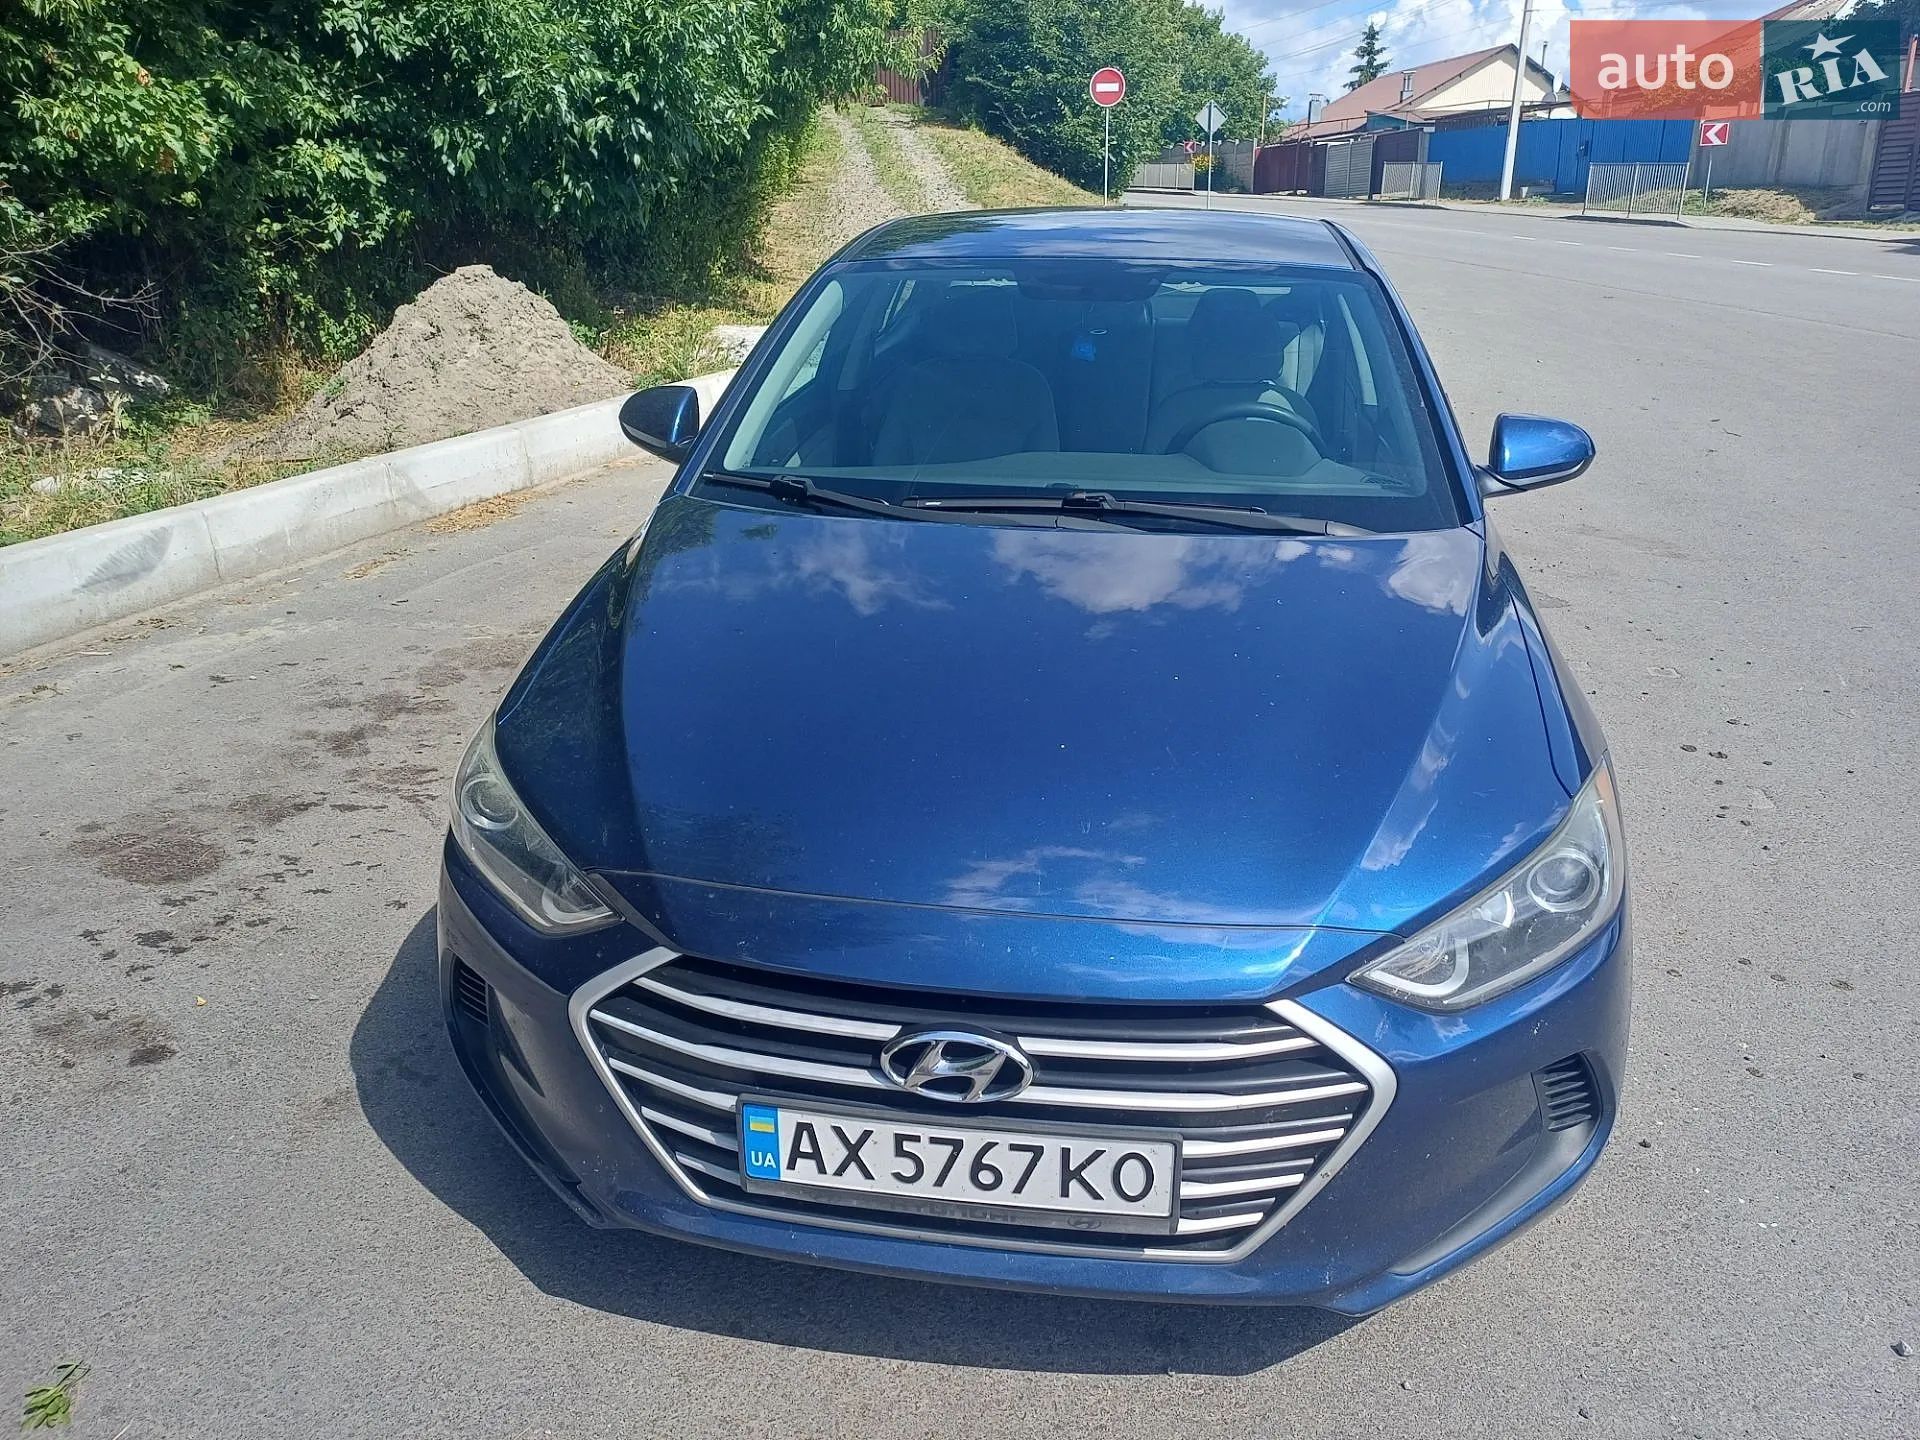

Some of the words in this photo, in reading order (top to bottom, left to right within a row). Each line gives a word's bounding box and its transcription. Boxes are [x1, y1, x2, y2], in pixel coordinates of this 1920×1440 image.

[751, 1151, 776, 1169] UA
[786, 1122, 875, 1180] AX
[892, 1132, 1044, 1194] 5767
[1059, 1147, 1155, 1203] KO
